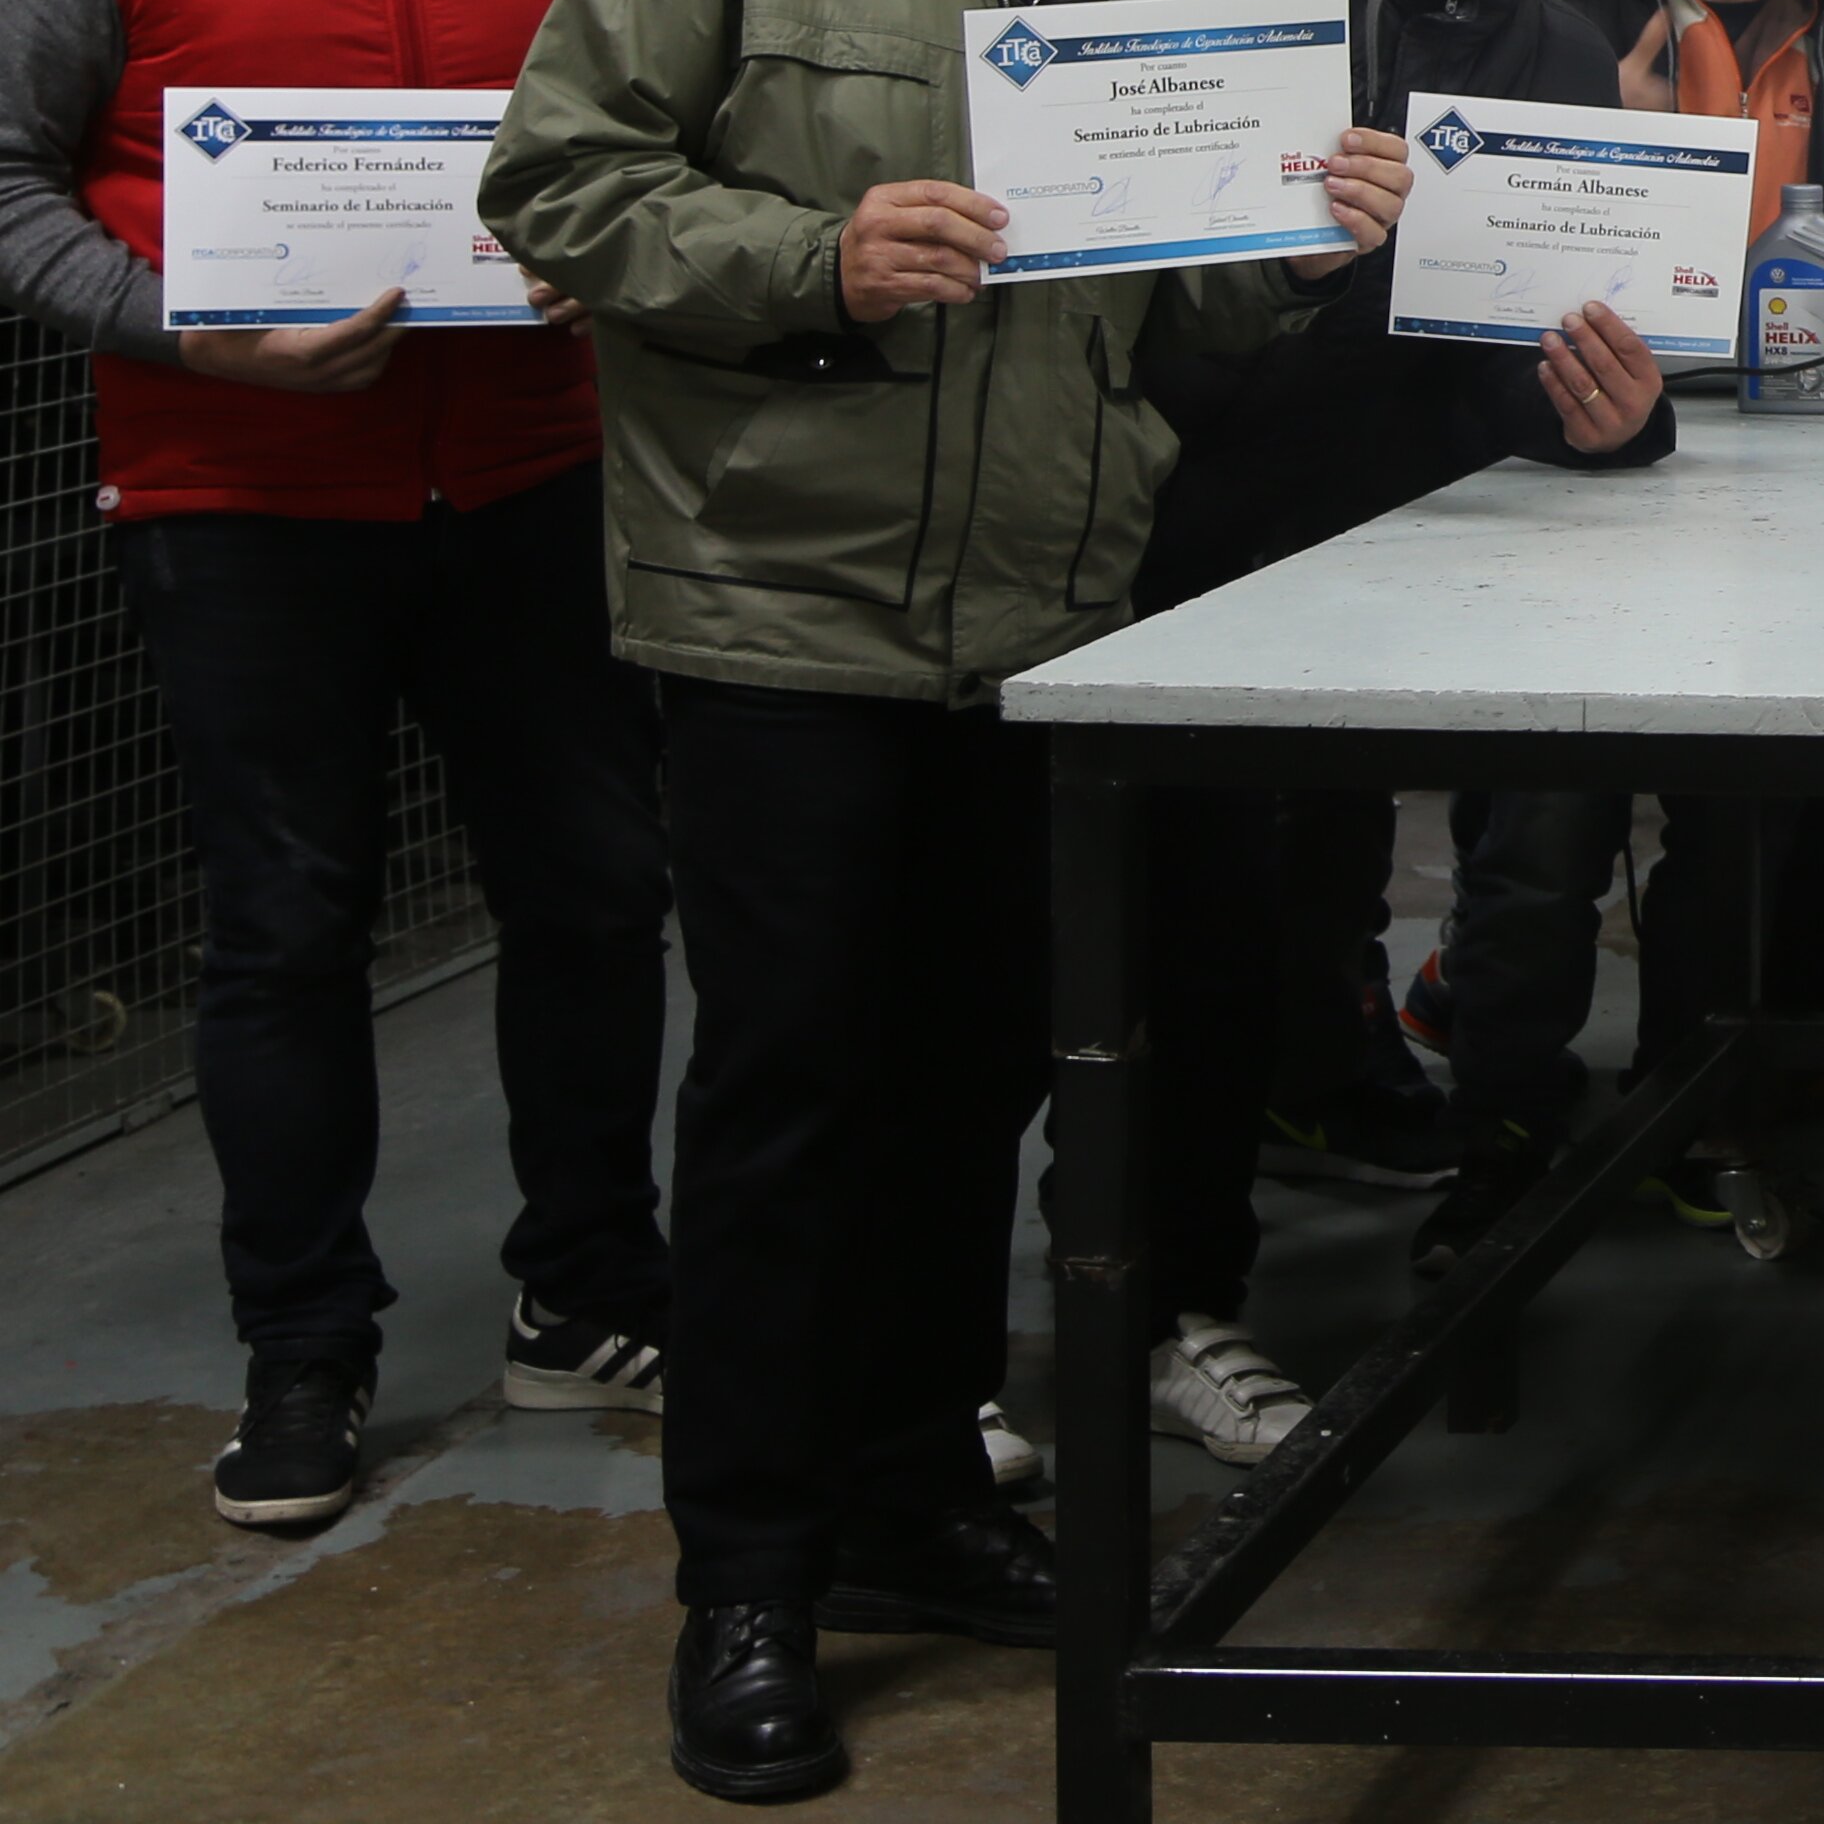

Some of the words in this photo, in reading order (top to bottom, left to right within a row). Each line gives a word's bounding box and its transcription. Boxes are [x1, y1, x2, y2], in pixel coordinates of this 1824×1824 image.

[1140, 62, 1155, 71] Por
[1157, 62, 1187, 71] cuanto
[1109, 79, 1146, 102] José
[1149, 76, 1225, 95] Albanese
[1131, 105, 1141, 115] ha
[1144, 103, 1194, 116] completado
[1196, 102, 1204, 110] el
[1073, 126, 1149, 143] Seminario
[1153, 122, 1170, 137] de
[1174, 117, 1260, 135] Lubricación
[1109, 148, 1146, 160] extiende
[1158, 145, 1193, 159] presente
[1195, 141, 1240, 153] certificado
[272, 157, 348, 173] Federico
[353, 155, 445, 172] Fernández
[1280, 158, 1327, 173] HELIX
[1507, 173, 1573, 194] Germán
[1577, 179, 1649, 199] Albanese
[262, 199, 339, 213] Seminario
[343, 199, 361, 213] de
[366, 198, 453, 213] Lubricación
[1486, 215, 1556, 234] Seminario
[1560, 220, 1577, 235] de
[1580, 222, 1661, 241] Lubricación
[473, 244, 504, 252] HEL
[1674, 265, 1695, 275] Shell
[1673, 273, 1718, 287] HELIX
[1765, 332, 1821, 344] HELIX
[1765, 347, 1788, 355] HX8
